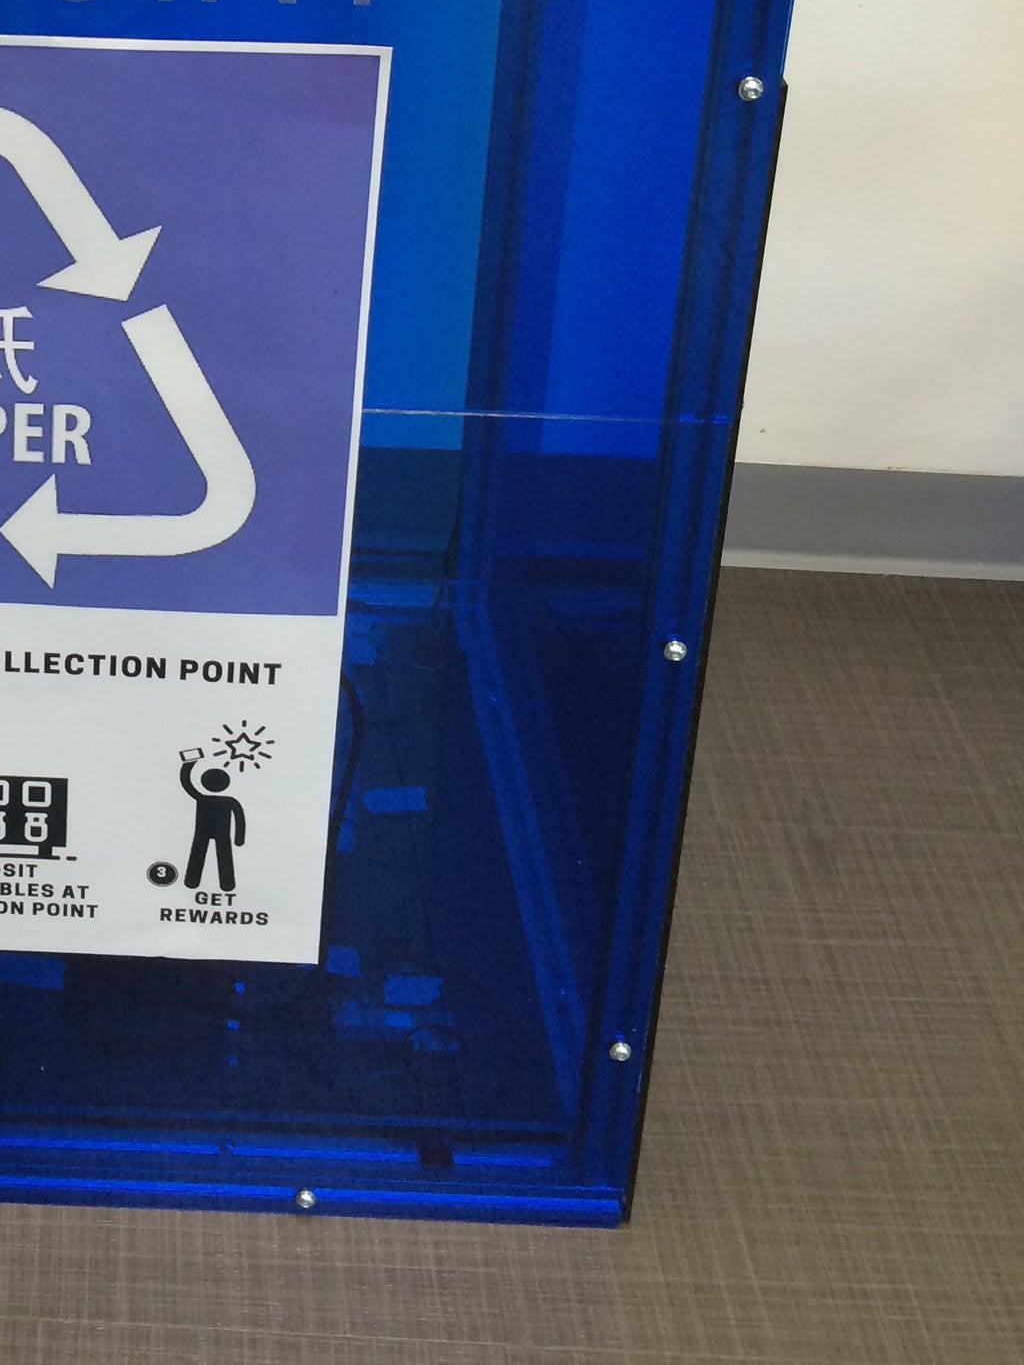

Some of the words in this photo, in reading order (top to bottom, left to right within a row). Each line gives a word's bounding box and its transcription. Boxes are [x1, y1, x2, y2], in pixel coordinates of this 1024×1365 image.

[179, 659, 282, 685] POINT
[156, 866, 167, 878] 3
[62, 885, 89, 900] AT
[194, 891, 237, 906] GET
[32, 902, 99, 919] POINT
[160, 907, 269, 926] REWARDS
